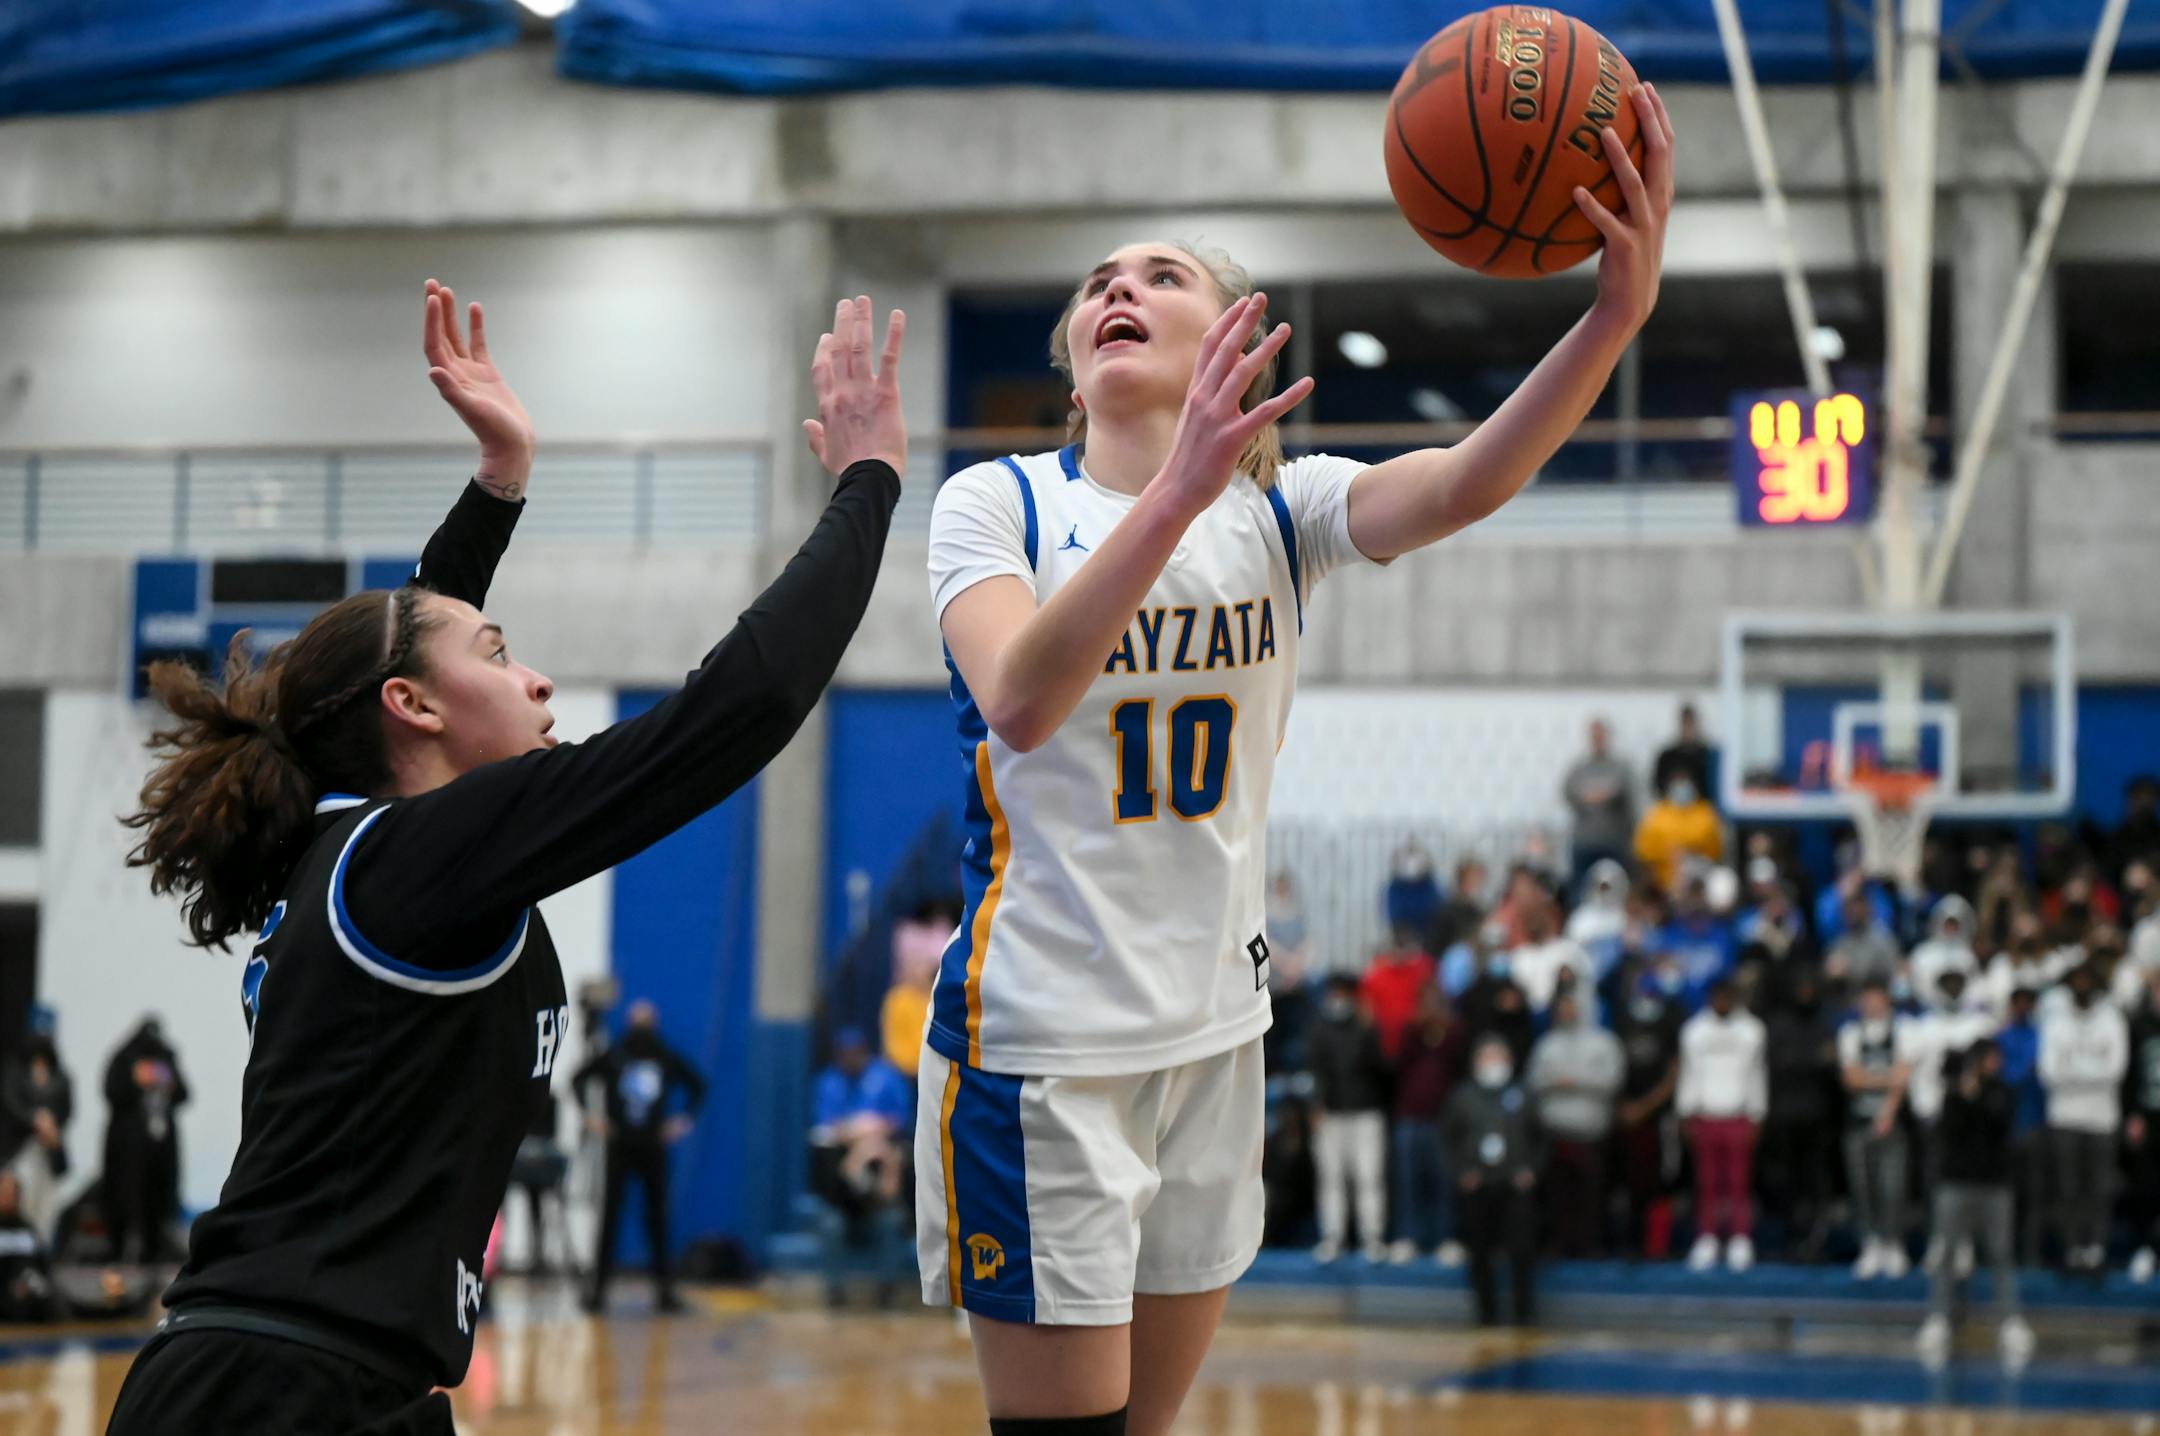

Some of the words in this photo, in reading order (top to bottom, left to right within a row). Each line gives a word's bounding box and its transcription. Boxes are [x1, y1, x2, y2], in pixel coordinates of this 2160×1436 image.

[1757, 437, 1850, 523] 30
[1103, 596, 1277, 675] AYZATA
[1109, 693, 1238, 825] 10
